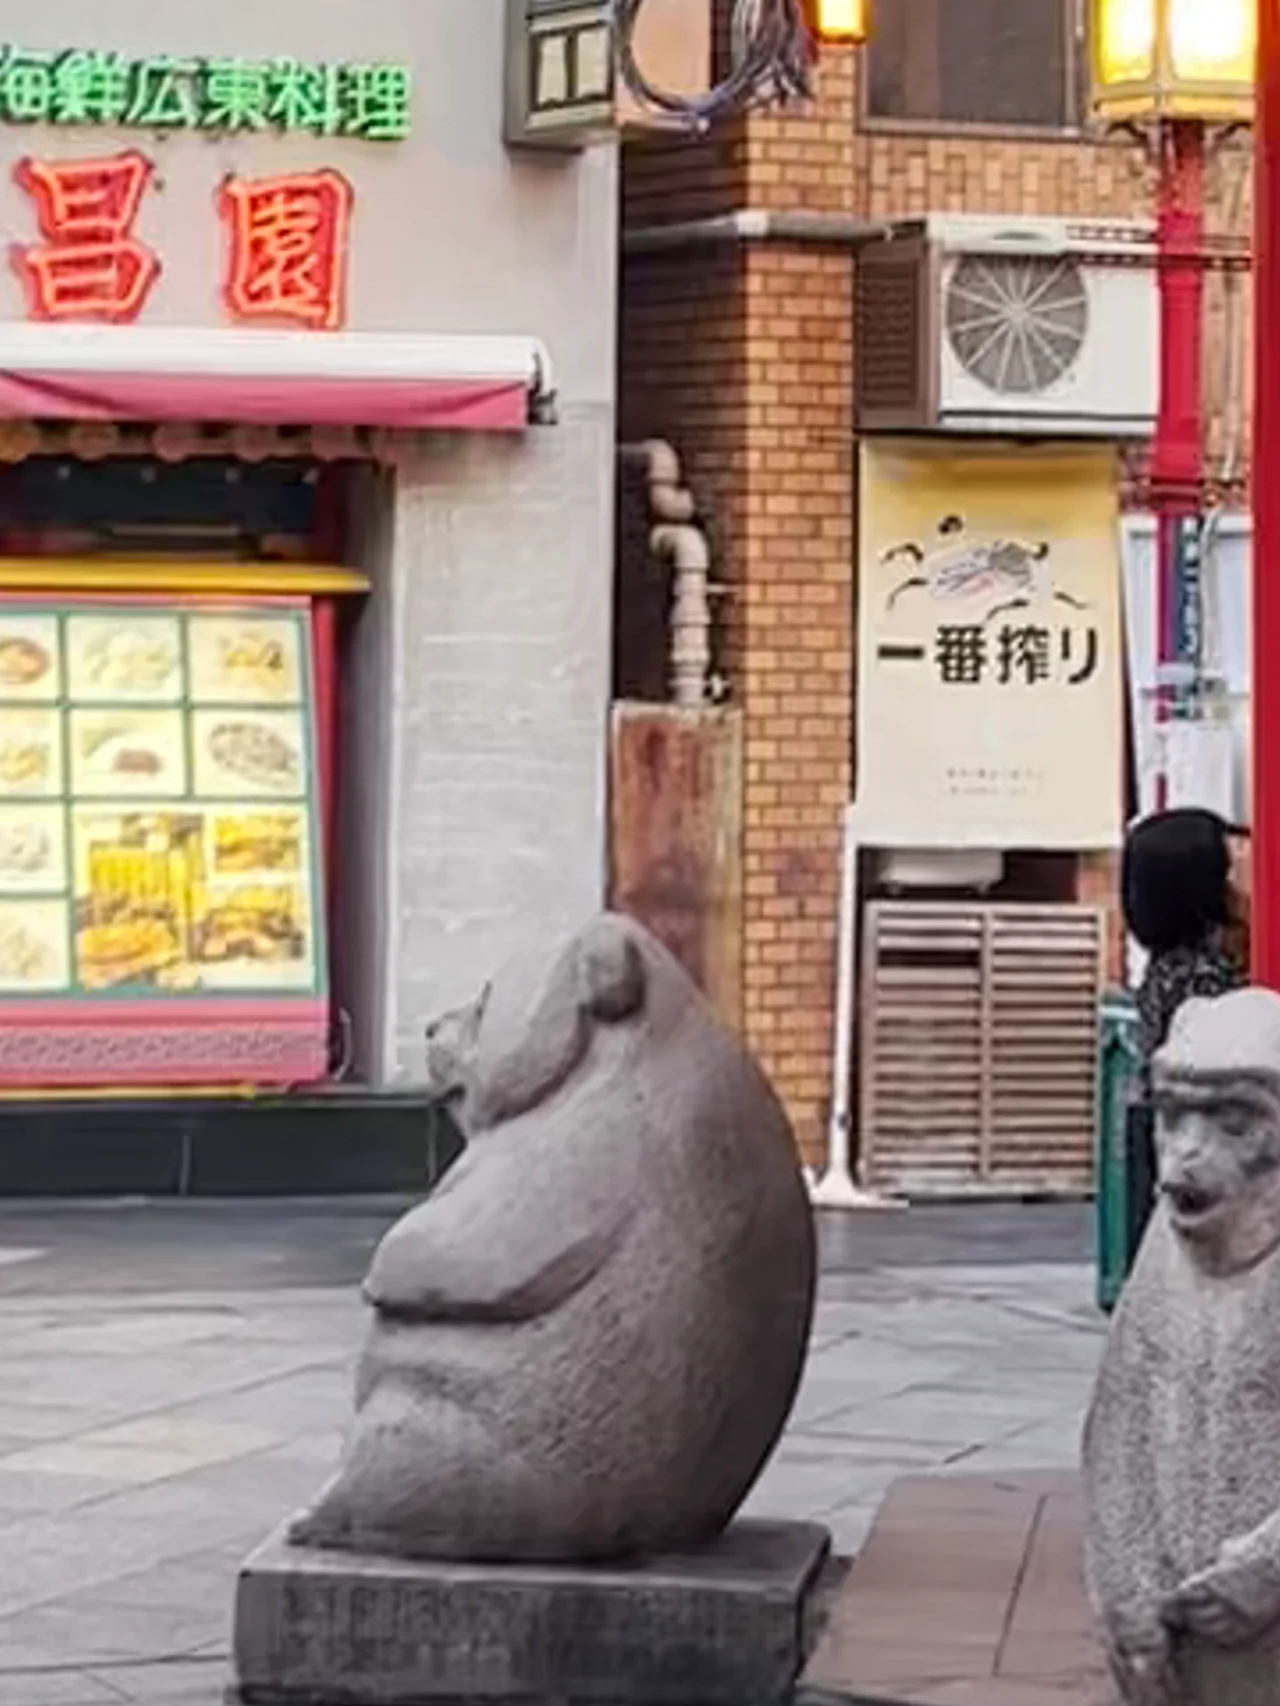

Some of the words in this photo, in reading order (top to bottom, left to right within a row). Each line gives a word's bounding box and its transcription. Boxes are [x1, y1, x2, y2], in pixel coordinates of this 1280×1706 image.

[11, 149, 355, 331] 昌園
[876, 623, 1099, 686] 一番搾り
